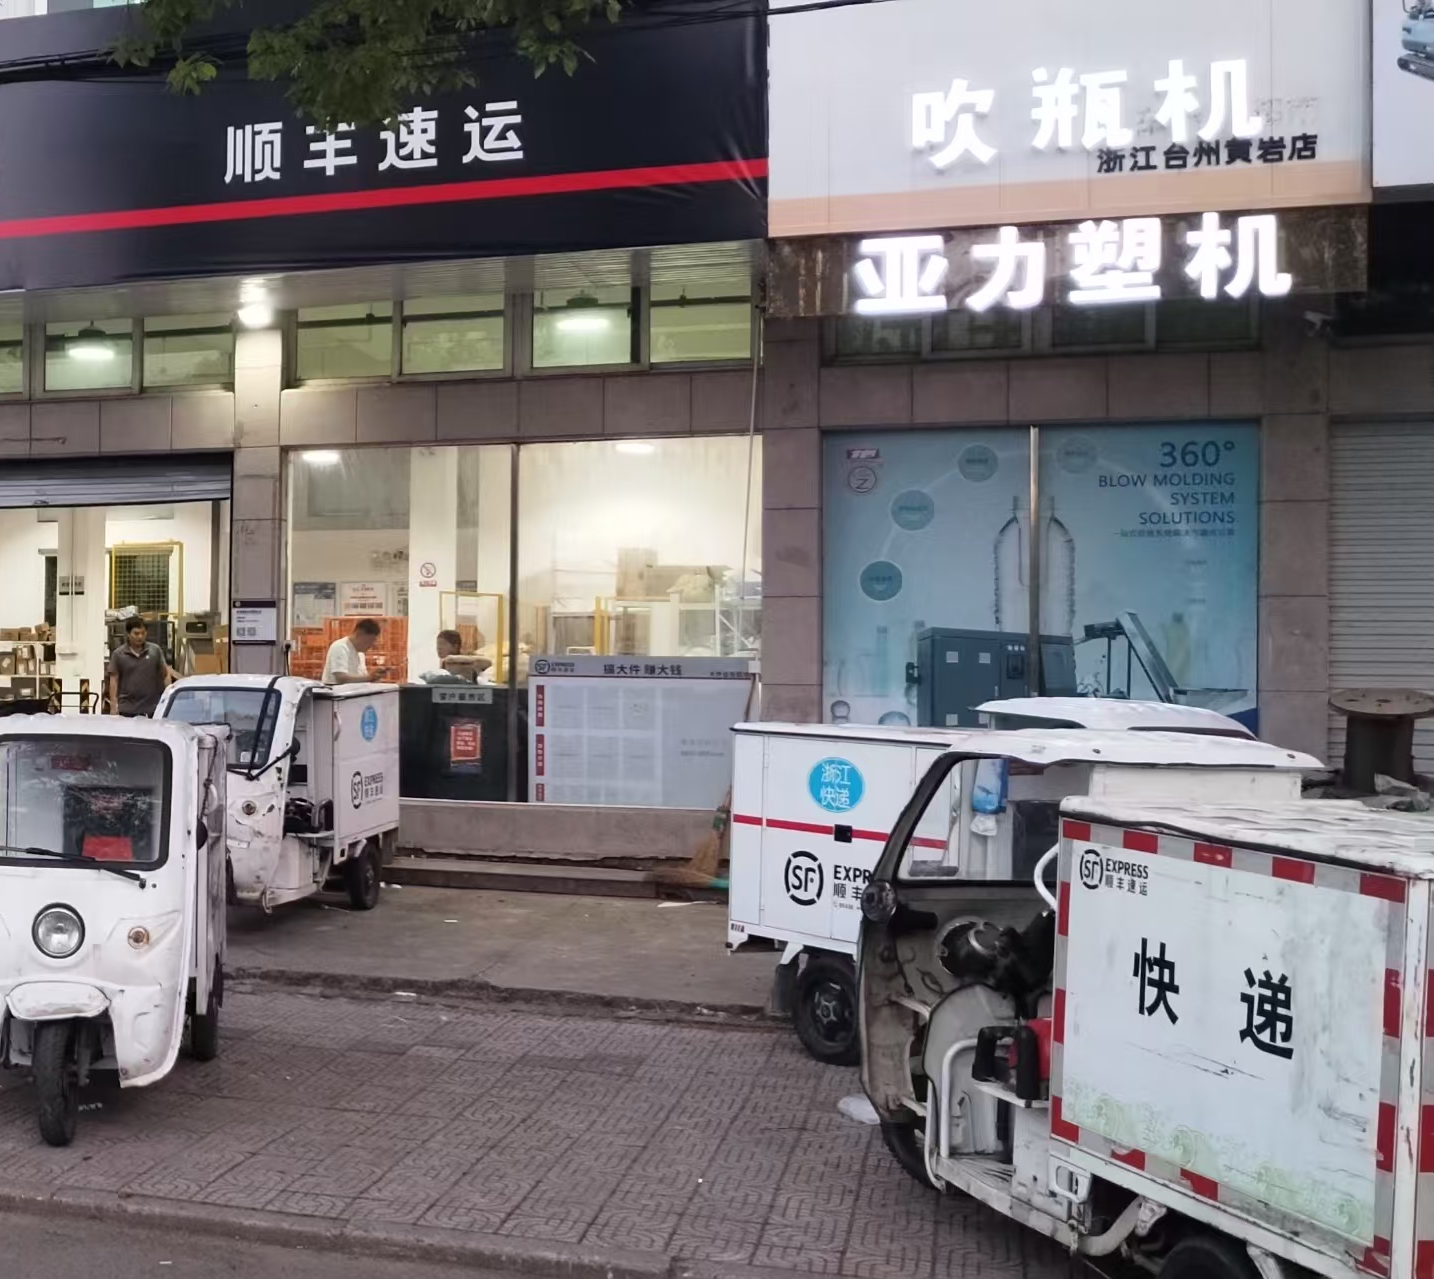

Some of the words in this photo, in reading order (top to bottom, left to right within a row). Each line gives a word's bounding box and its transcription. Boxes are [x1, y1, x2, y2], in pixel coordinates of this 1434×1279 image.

[911, 58, 1263, 170] 吹瓶机
[223, 100, 524, 184] 顺丰速运
[1096, 133, 1318, 174] 浙江台州黄岩店
[853, 211, 1293, 316] 亚力塑机
[1158, 440, 1236, 468] 360°
[1098, 473, 1147, 488] BLOW
[1153, 472, 1236, 487] MOLDING
[1169, 491, 1235, 506] SYSTEM
[1139, 511, 1236, 525] SOLUTIONS
[821, 761, 852, 785] 浙江
[820, 786, 851, 809] 快递
[833, 864, 872, 884] EXPR
[1105, 858, 1149, 880] EXPRESS
[833, 882, 863, 901] 顺丰
[1104, 873, 1148, 896] 顺丰速运
[1132, 937, 1294, 1061] 快递
